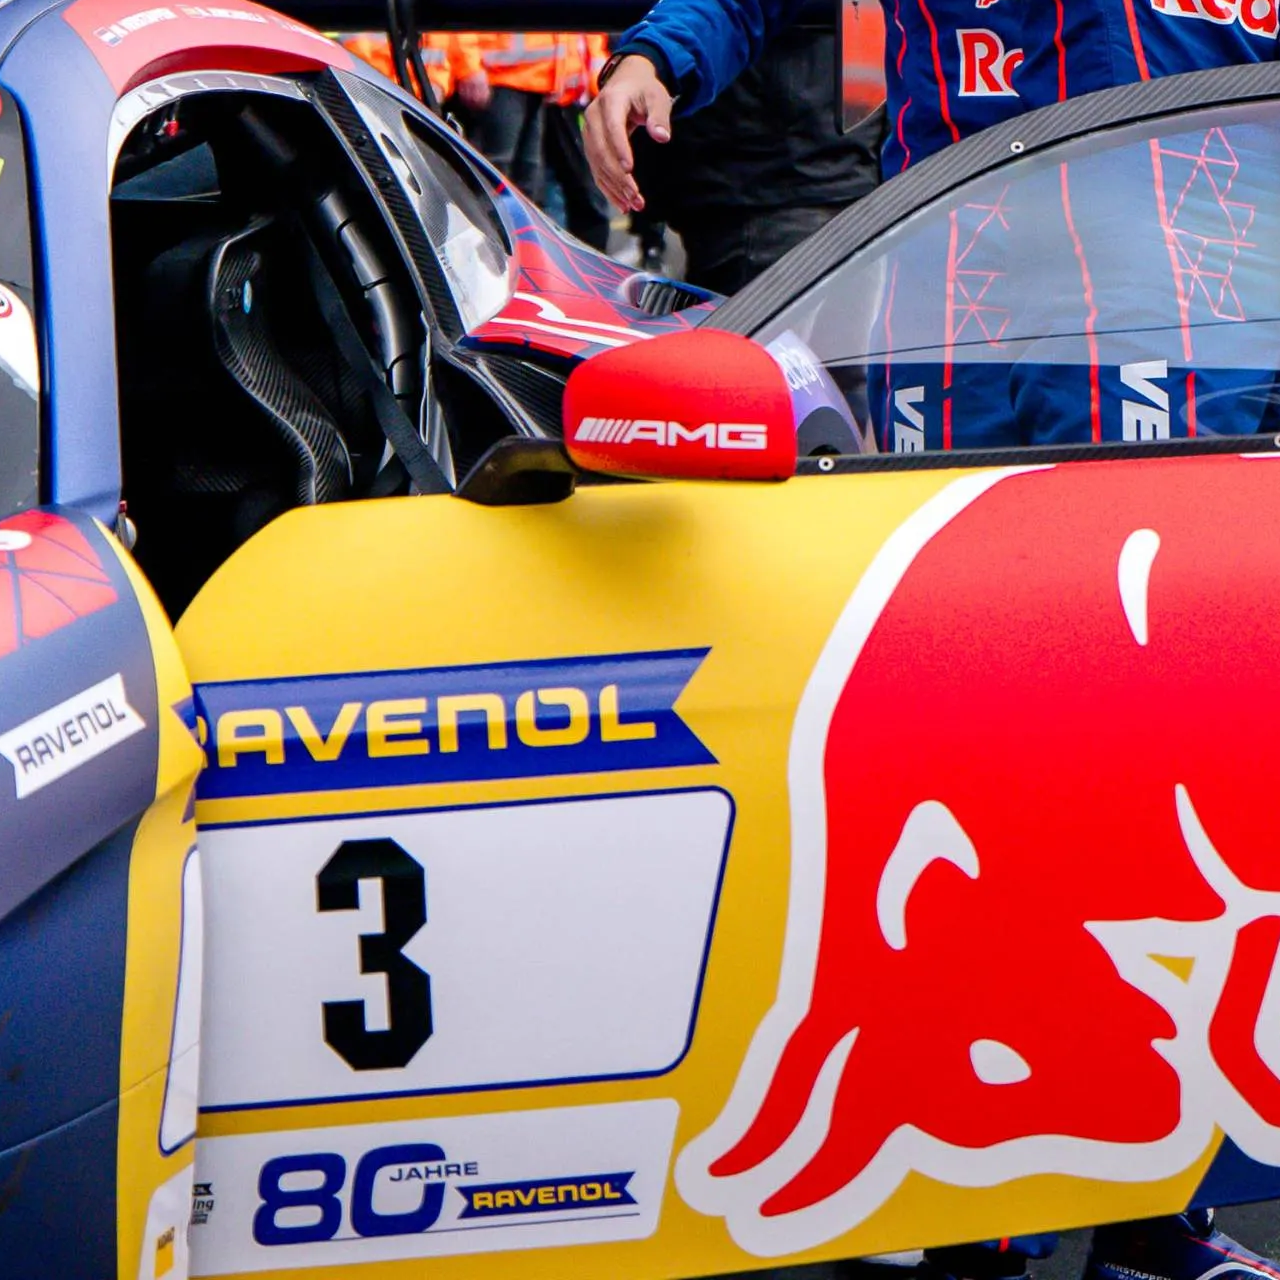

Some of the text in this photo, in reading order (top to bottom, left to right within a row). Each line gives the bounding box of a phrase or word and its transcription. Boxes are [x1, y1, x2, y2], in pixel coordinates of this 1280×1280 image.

[621, 418, 768, 450] AMG
[14, 691, 128, 773] RAVENOL
[315, 836, 434, 1072] 3
[252, 1142, 480, 1247] 80 JAHRE
[471, 1181, 623, 1210] RAVENOL
